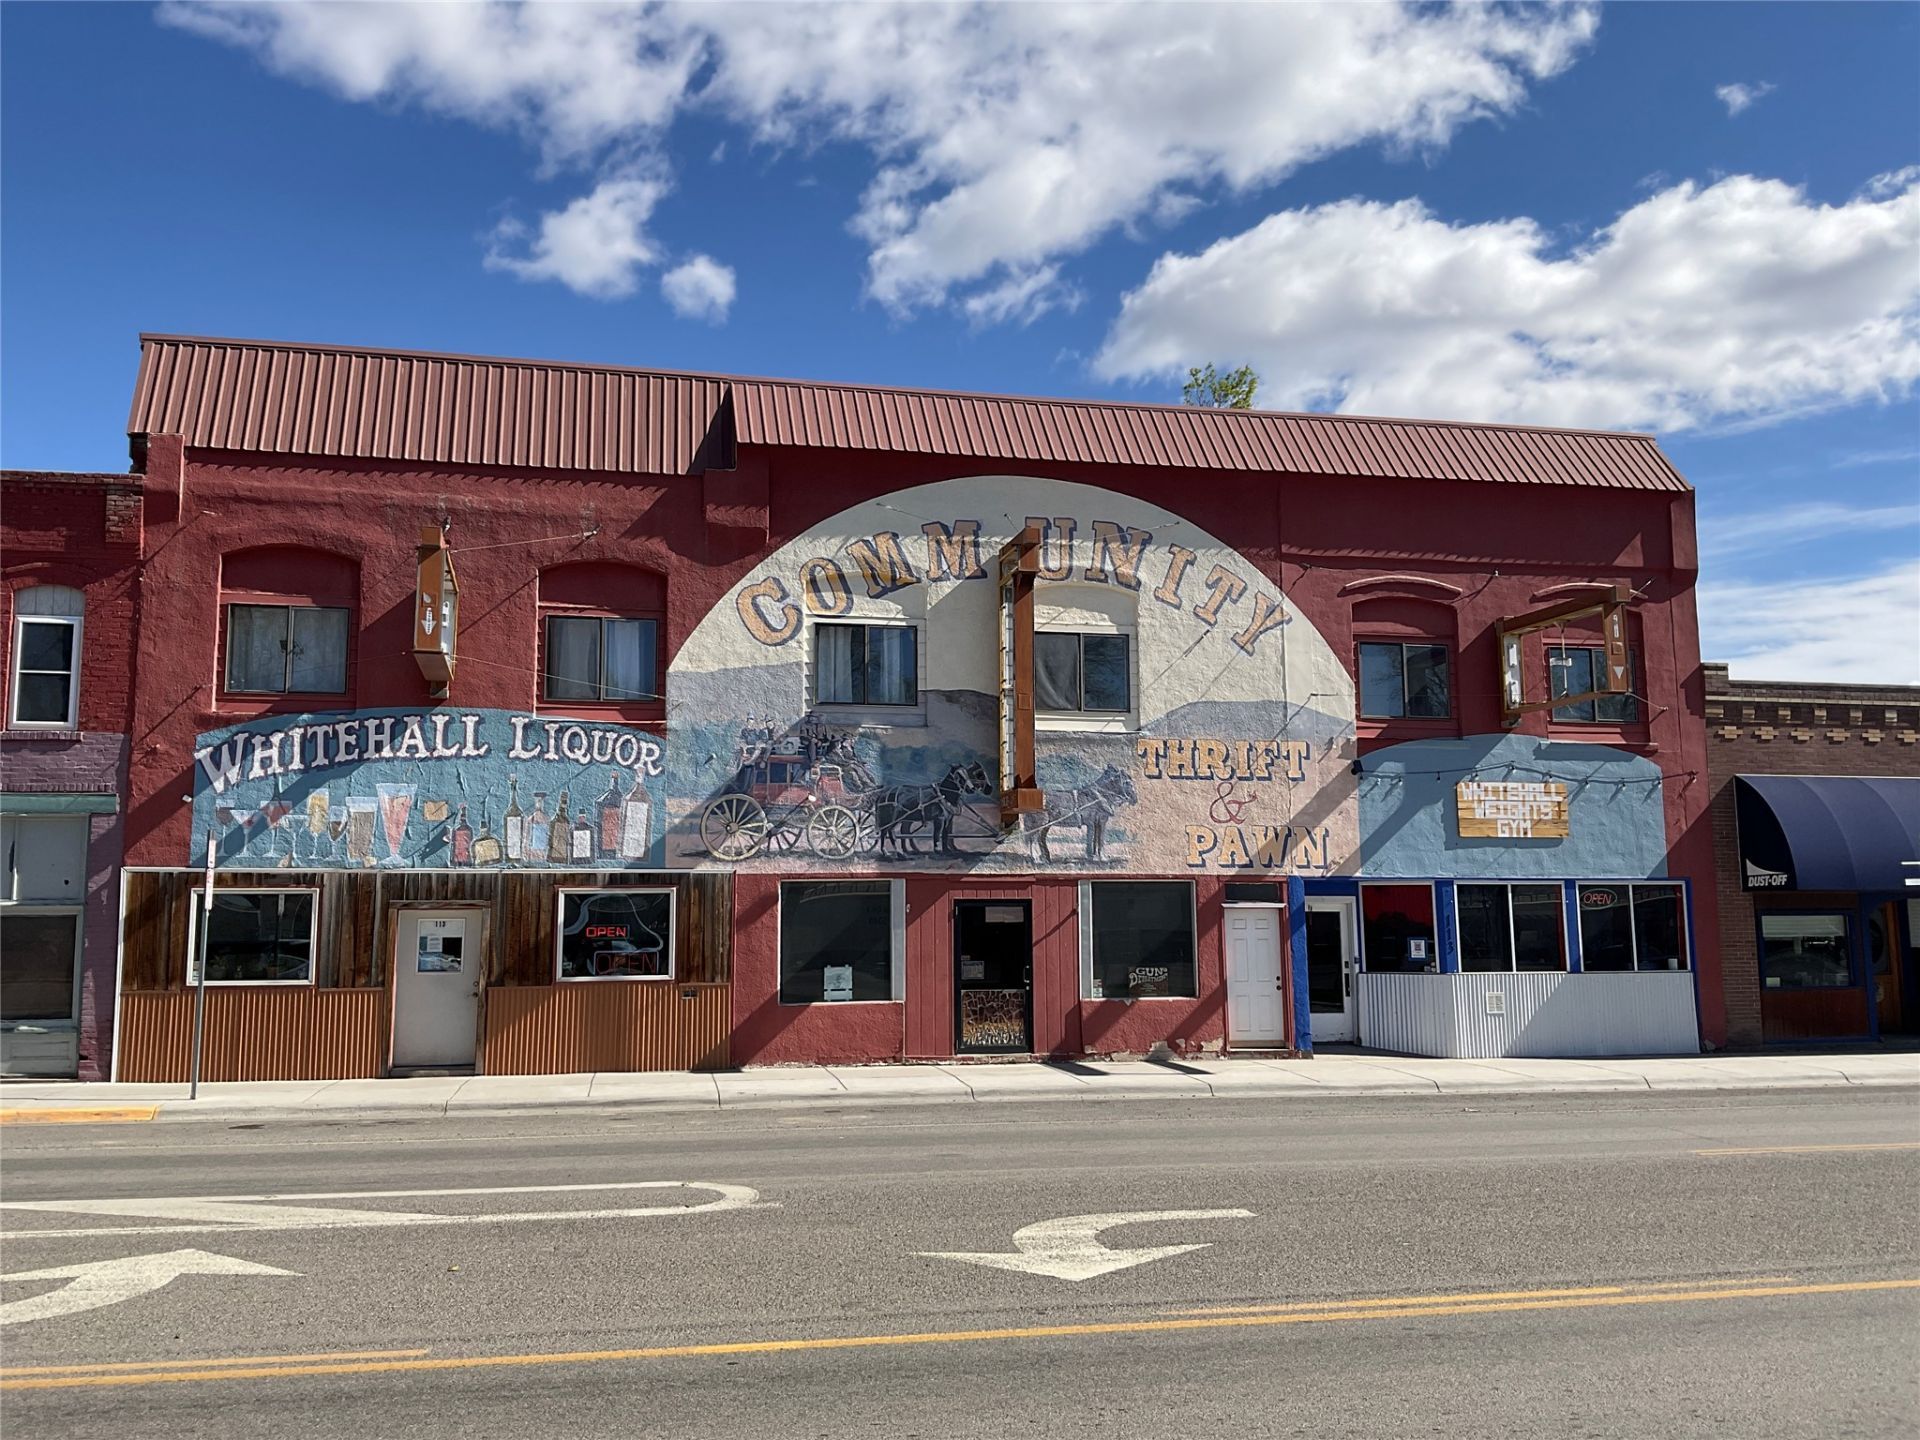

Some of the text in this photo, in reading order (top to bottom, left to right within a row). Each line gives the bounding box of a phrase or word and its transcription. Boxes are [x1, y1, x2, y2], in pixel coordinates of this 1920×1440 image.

[736, 516, 1292, 657] COMMUNITY
[193, 712, 664, 795] WHITEHALL LIQUOR
[1137, 738, 1311, 782] THRIFT
[1209, 781, 1258, 825] &
[1461, 782, 1564, 801] WHITEHALL
[1473, 800, 1553, 819] WEIGHTS
[1496, 819, 1532, 837] GYM
[1185, 824, 1329, 869] PAWN
[1583, 892, 1612, 905] OPEN
[586, 926, 627, 938] OPEN
